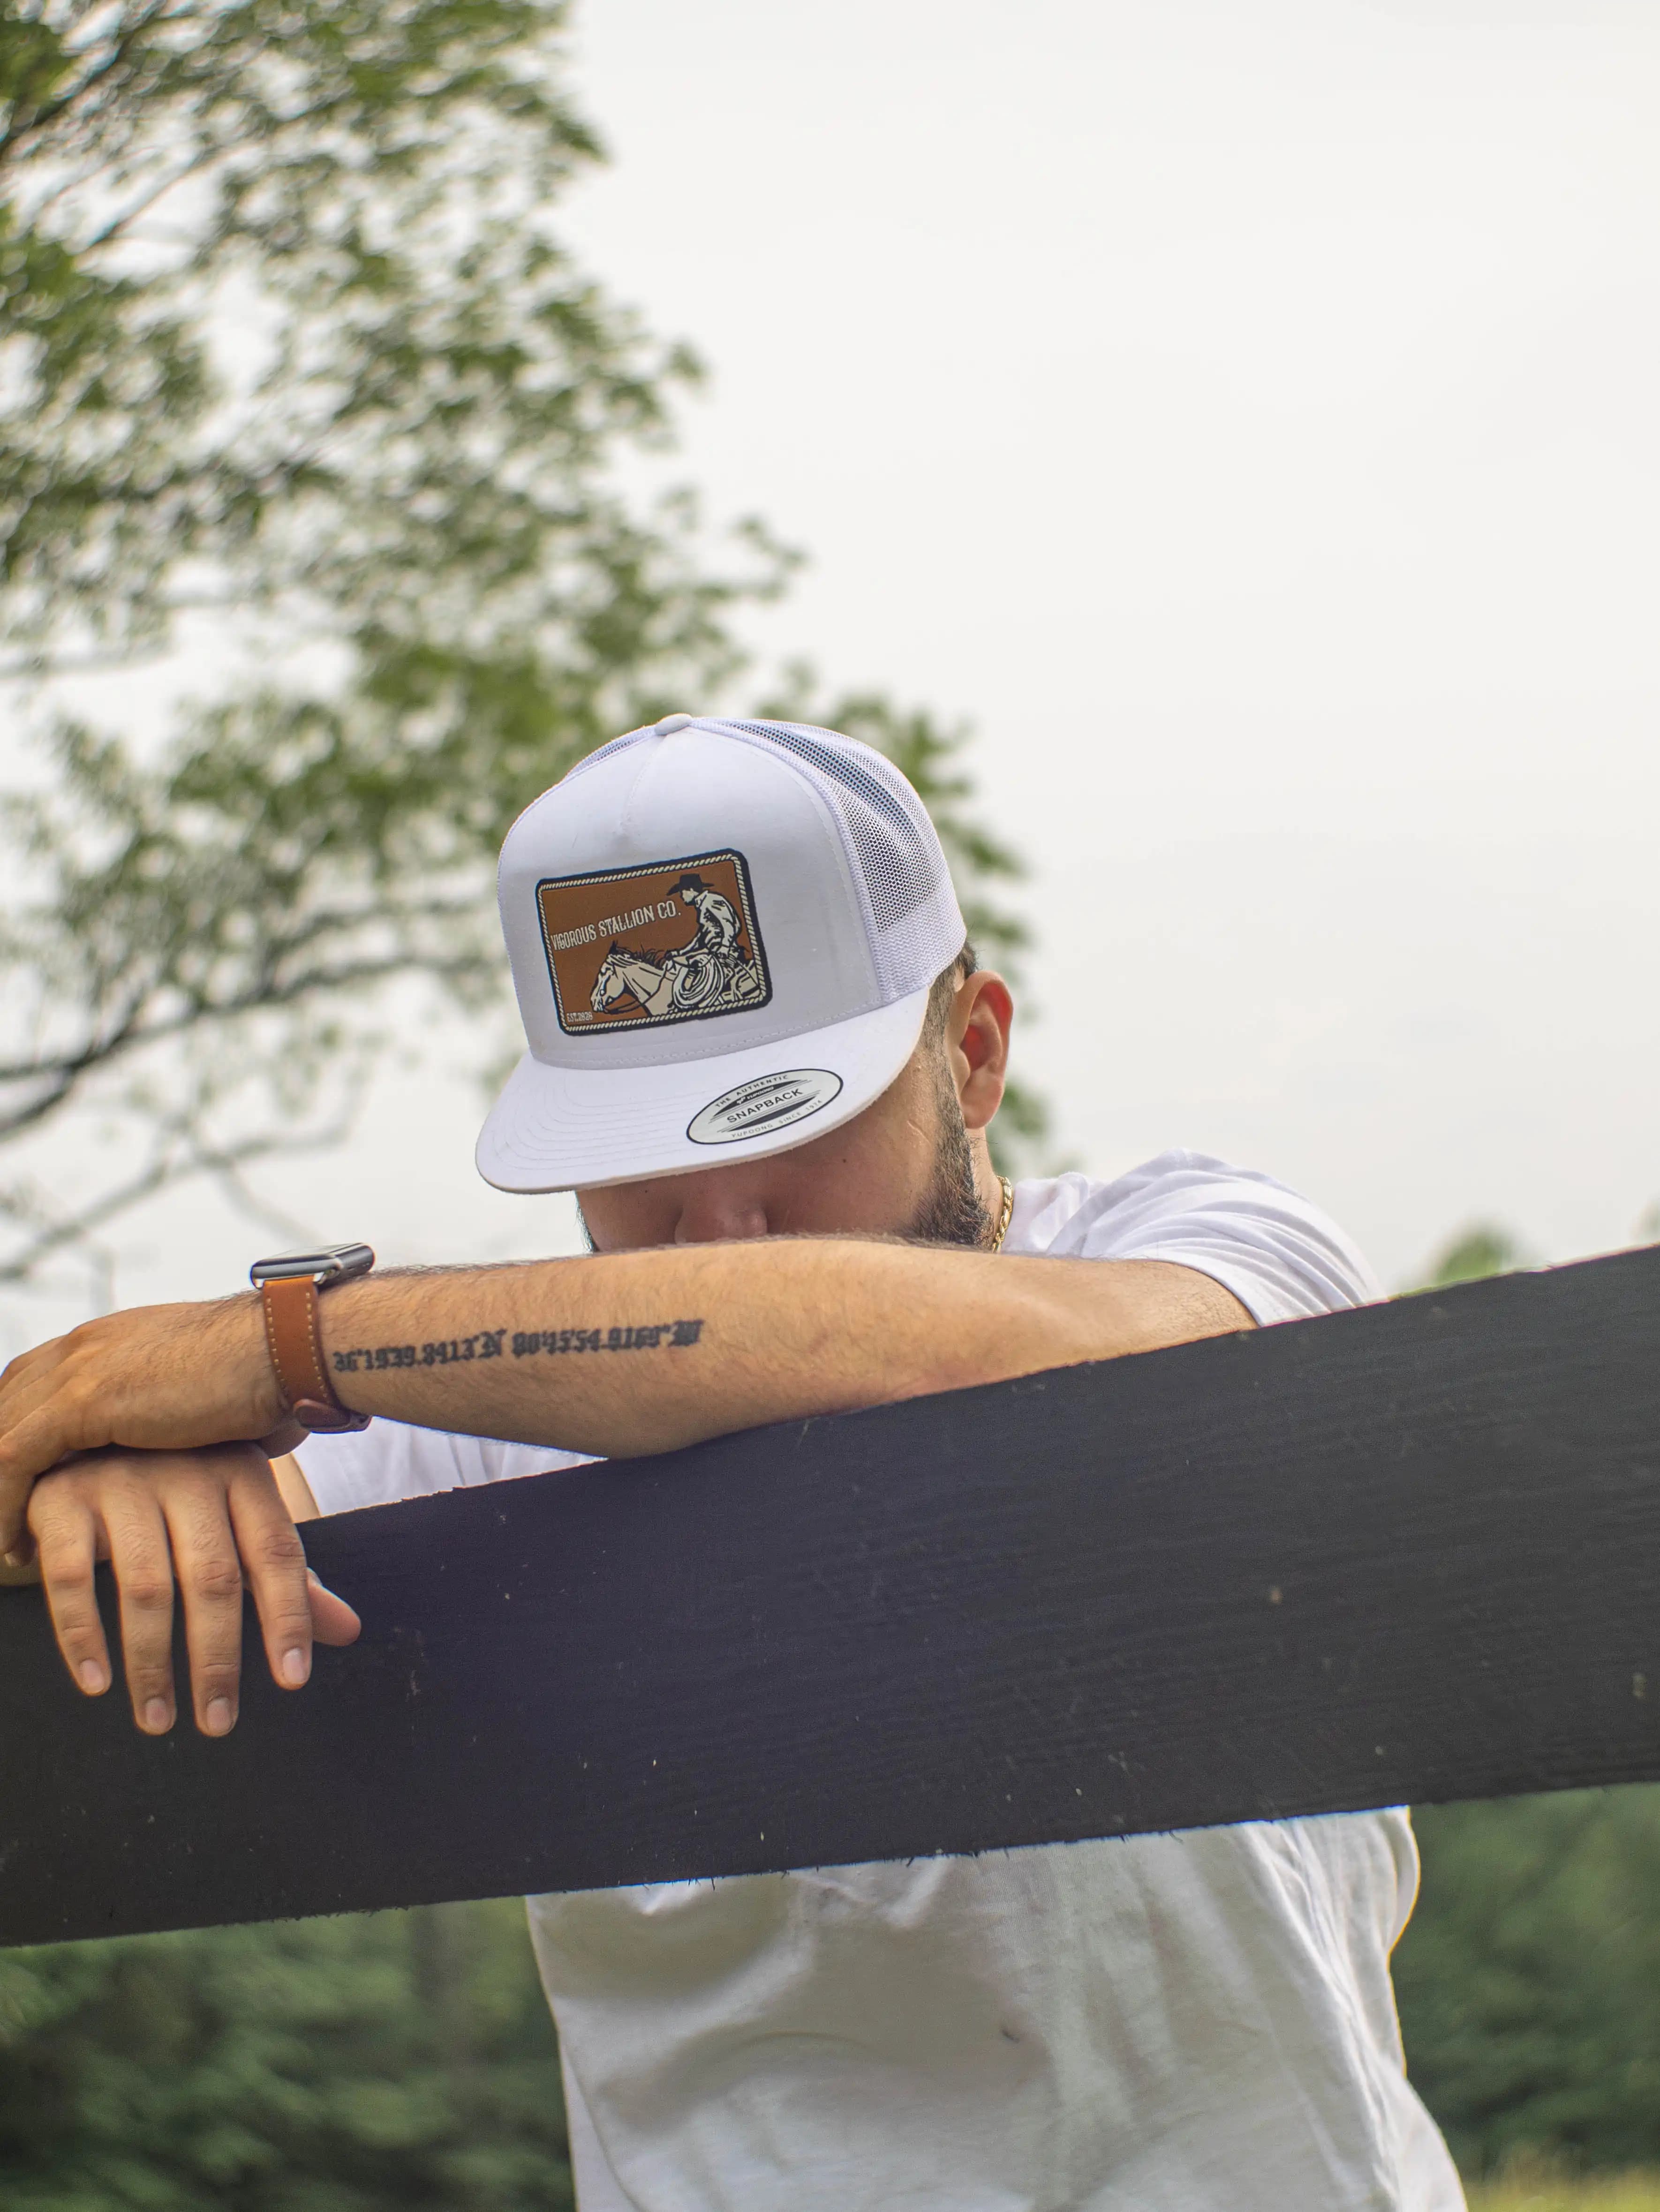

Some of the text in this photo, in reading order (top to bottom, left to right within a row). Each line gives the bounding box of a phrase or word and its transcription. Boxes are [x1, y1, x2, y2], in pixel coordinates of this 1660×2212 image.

[551, 900, 681, 950] VIGOROUS STALLION CO.
[715, 1098, 732, 1107] THE
[736, 1075, 788, 1096] AUTHENTIC
[727, 1088, 803, 1123] SNAPBACK
[731, 1124, 773, 1137] YUPOONG
[779, 1112, 801, 1124] SINCE
